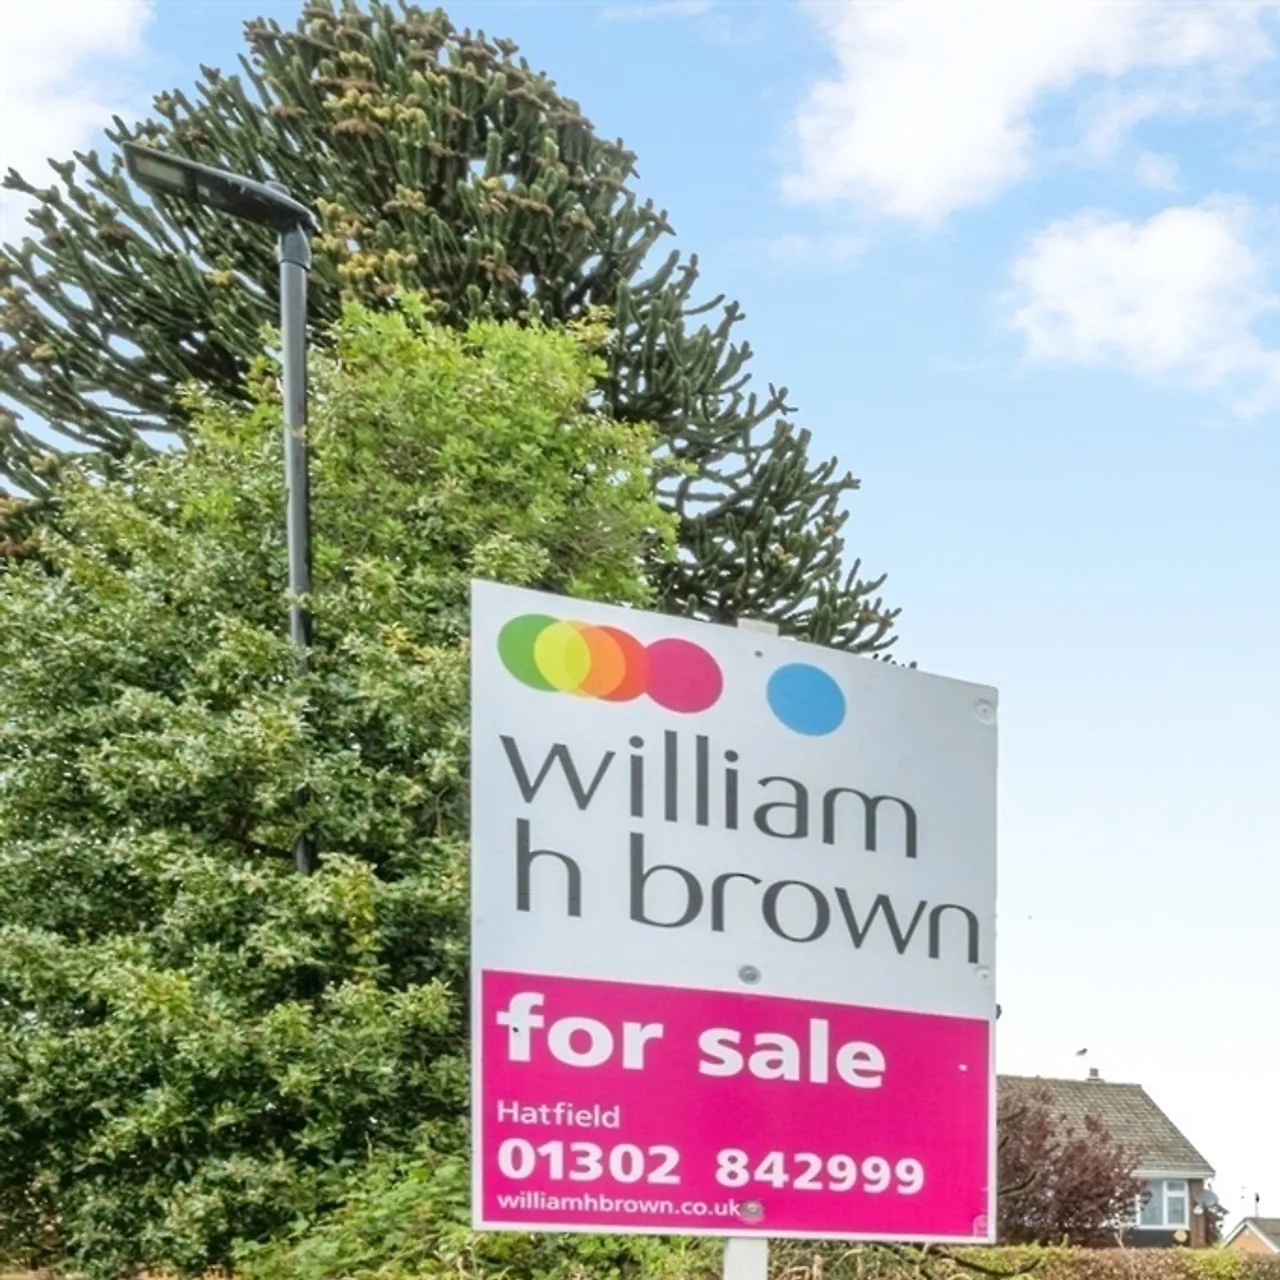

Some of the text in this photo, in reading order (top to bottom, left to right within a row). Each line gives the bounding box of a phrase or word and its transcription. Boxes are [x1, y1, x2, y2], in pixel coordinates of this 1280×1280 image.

[499, 730, 918, 858] william
[516, 817, 979, 963] h brown
[497, 992, 886, 1089] for sale
[497, 1100, 621, 1130] Hatfield
[497, 1191, 741, 1217] williamhbrown.co.uk
[498, 1138, 924, 1196] 01302 842999
